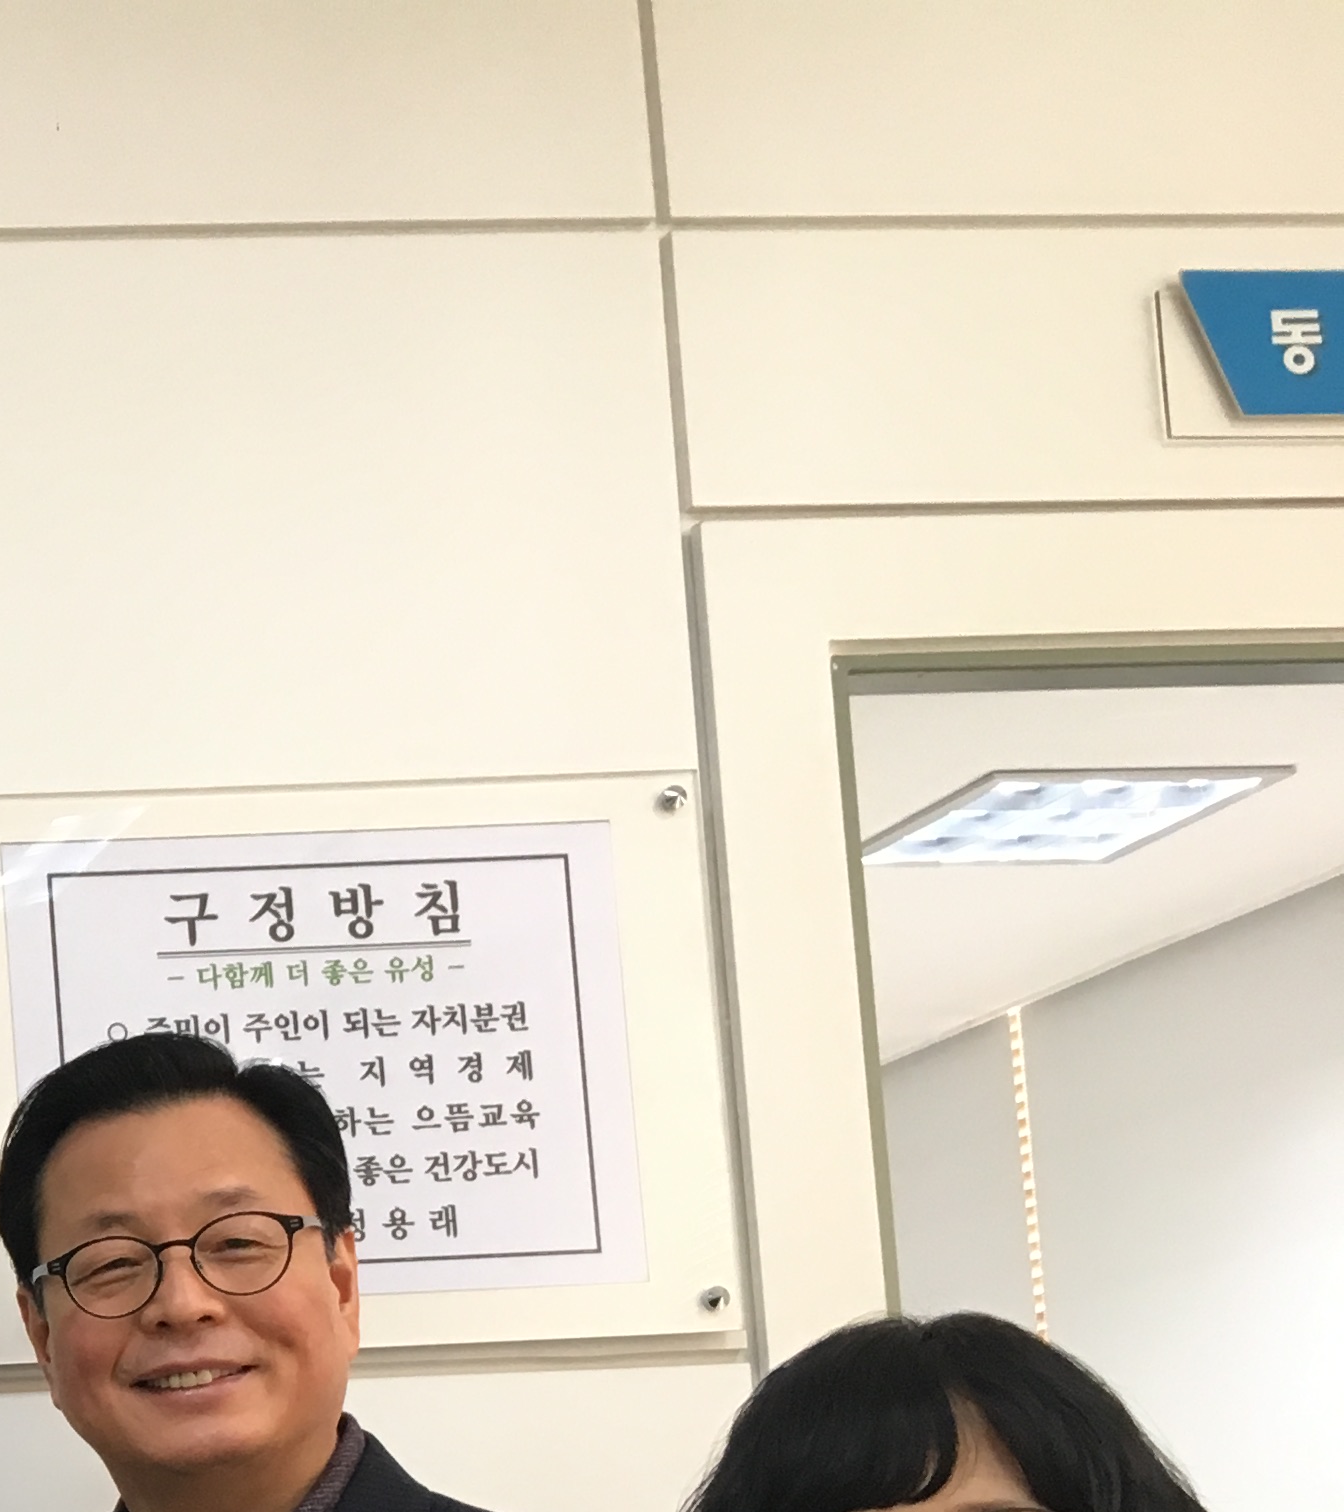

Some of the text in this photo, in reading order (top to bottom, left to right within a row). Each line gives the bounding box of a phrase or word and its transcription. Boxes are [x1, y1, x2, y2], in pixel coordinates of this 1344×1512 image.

[1270, 309, 1323, 375] 동
[198, 953, 436, 990] 다함께 더 좋은 유성
[243, 1008, 330, 1043] 주인이
[342, 1008, 401, 1040] 되는
[411, 1001, 529, 1037] 자치분권
[412, 1099, 541, 1134] 으뜸교육
[353, 1147, 539, 1187] 좋은 건강도시
